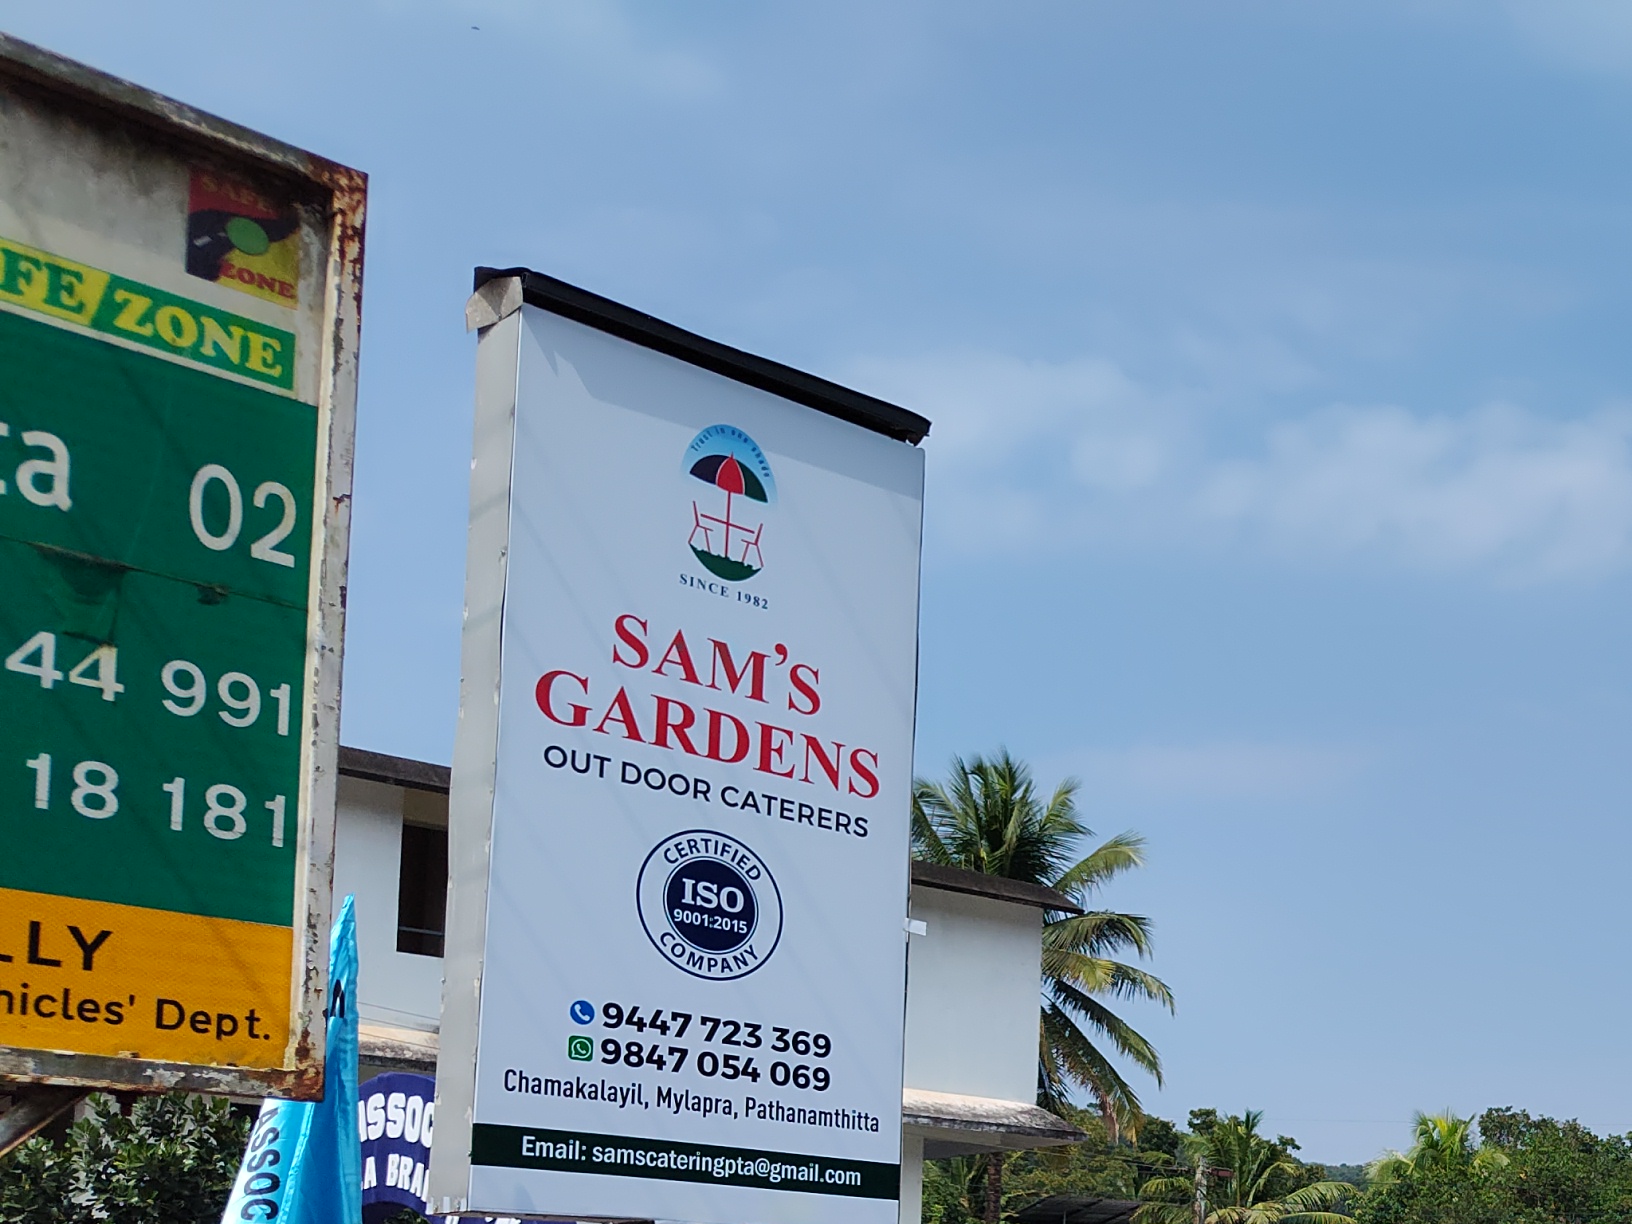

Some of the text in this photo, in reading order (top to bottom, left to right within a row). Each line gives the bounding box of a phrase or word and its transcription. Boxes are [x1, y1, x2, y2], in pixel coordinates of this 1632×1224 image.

[219, 258, 297, 299] ZONE
[113, 291, 283, 377] ZONE
[189, 464, 297, 568] 02
[679, 573, 769, 610] SINCE 1982
[5, 631, 291, 736] 44 991
[612, 614, 821, 715] SAM'S
[535, 670, 880, 798] GARDENS
[26, 753, 286, 848] 18 181
[543, 745, 868, 837] OUT DOOR CATERERS
[663, 838, 762, 882] CERTIFIED
[673, 908, 749, 934] 9001:2015
[681, 877, 744, 914] ISO
[659, 931, 760, 974] COMPANY
[155, 997, 270, 1040] Dept.
[601, 1002, 832, 1058] 9447 723 369
[600, 1037, 832, 1092] 9847 054 069
[503, 1069, 880, 1133] Chamakalayil, Mylapra, Pathanamthitta
[521, 1135, 862, 1187] Email: samscateringpta@gmail.com
